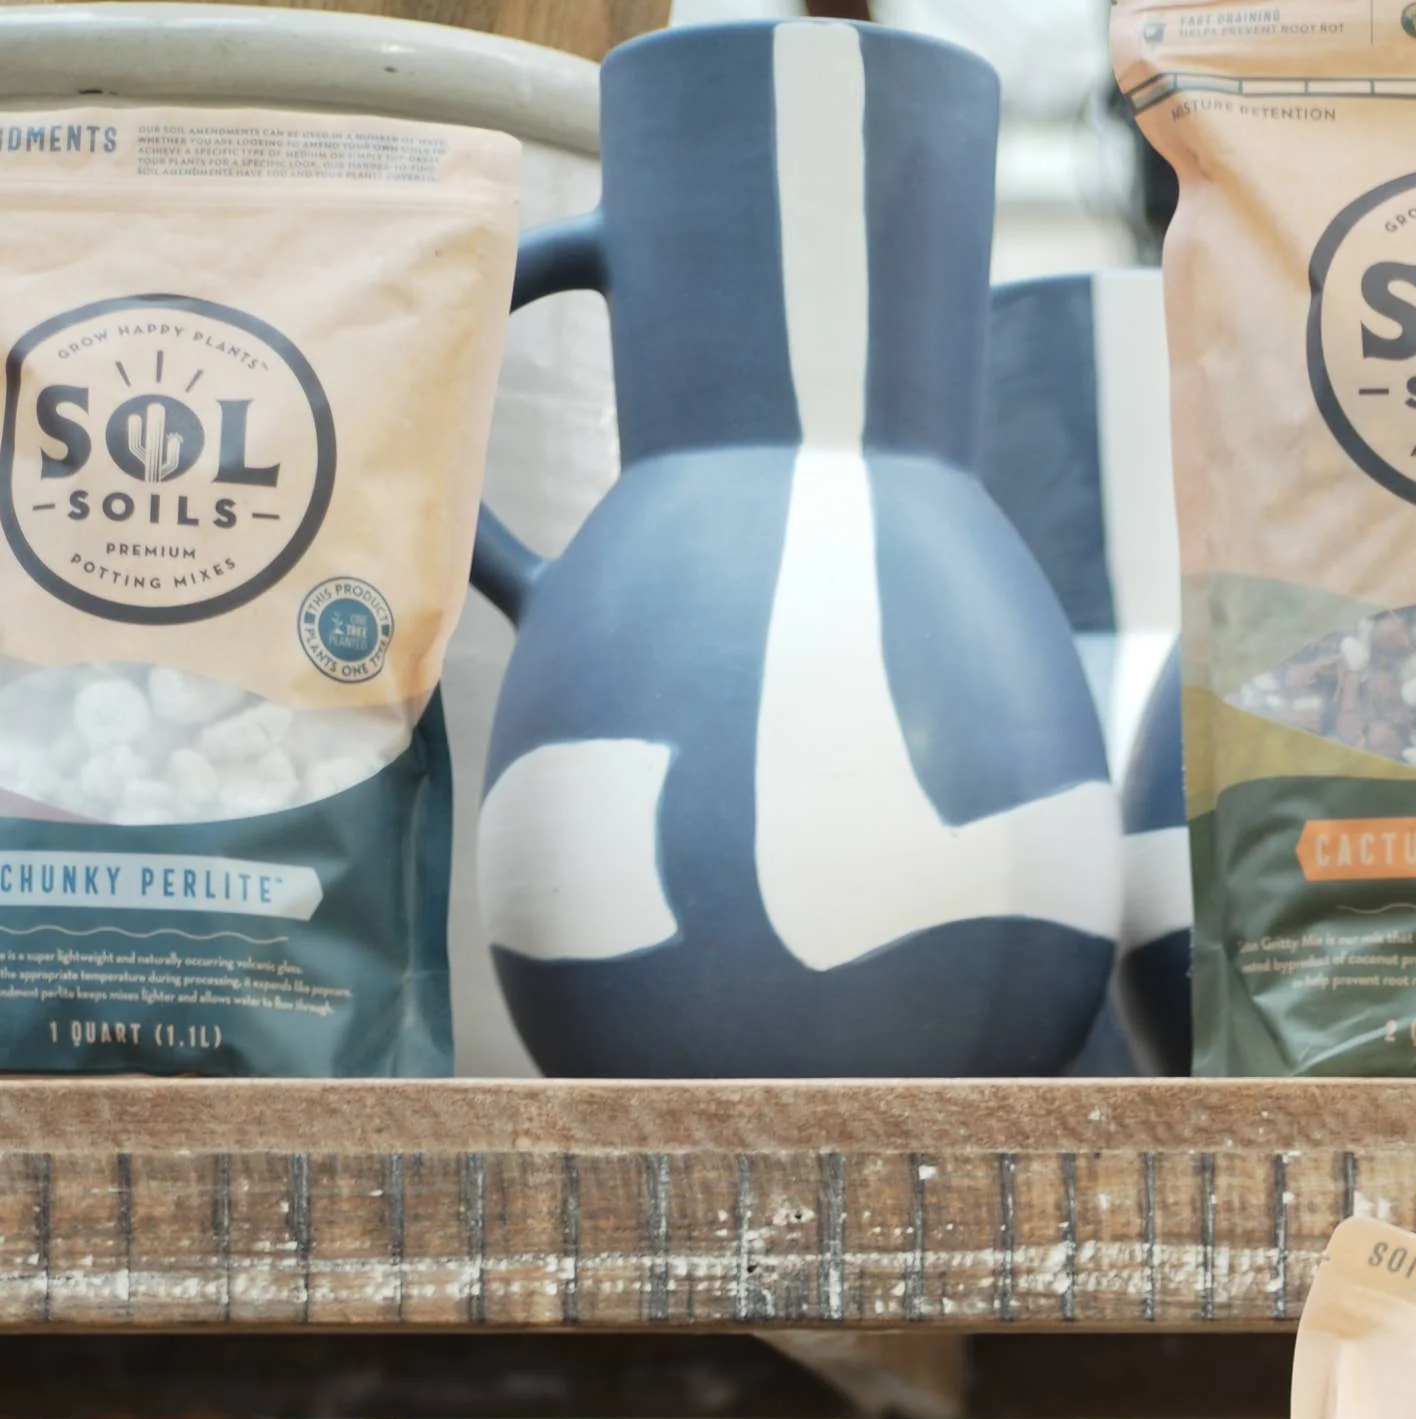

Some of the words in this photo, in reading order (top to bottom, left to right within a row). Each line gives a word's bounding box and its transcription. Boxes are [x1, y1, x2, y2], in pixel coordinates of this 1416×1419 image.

[1218, 10, 1281, 23] DRAINING
[1221, 24, 1277, 36] PREVENT
[1281, 23, 1317, 34] ROOT
[1320, 23, 1344, 34] ROT
[1240, 106, 1336, 121] RETENTION
[58, 328, 108, 360] GROW
[118, 323, 184, 338] HAPPY
[37, 384, 280, 487] SOL
[68, 491, 238, 529] SOILS
[106, 542, 196, 560] PREMIUM
[71, 553, 161, 590] POTTING
[174, 557, 236, 588] MIXES
[307, 587, 332, 612] THIS
[335, 584, 389, 623] PRODUCT
[305, 628, 337, 672] PLANTS
[342, 663, 368, 676] ONE
[1, 863, 121, 896] CHUNKY
[57, 948, 114, 966] lightweight
[116, 951, 135, 963] and
[138, 952, 182, 968] naturally
[20, 969, 78, 983] appropriate
[81, 970, 145, 984] temperature
[148, 970, 181, 987] during
[49, 1022, 57, 1042] 1
[71, 1023, 141, 1048] QUART
[155, 1023, 222, 1048] (1.1L)
